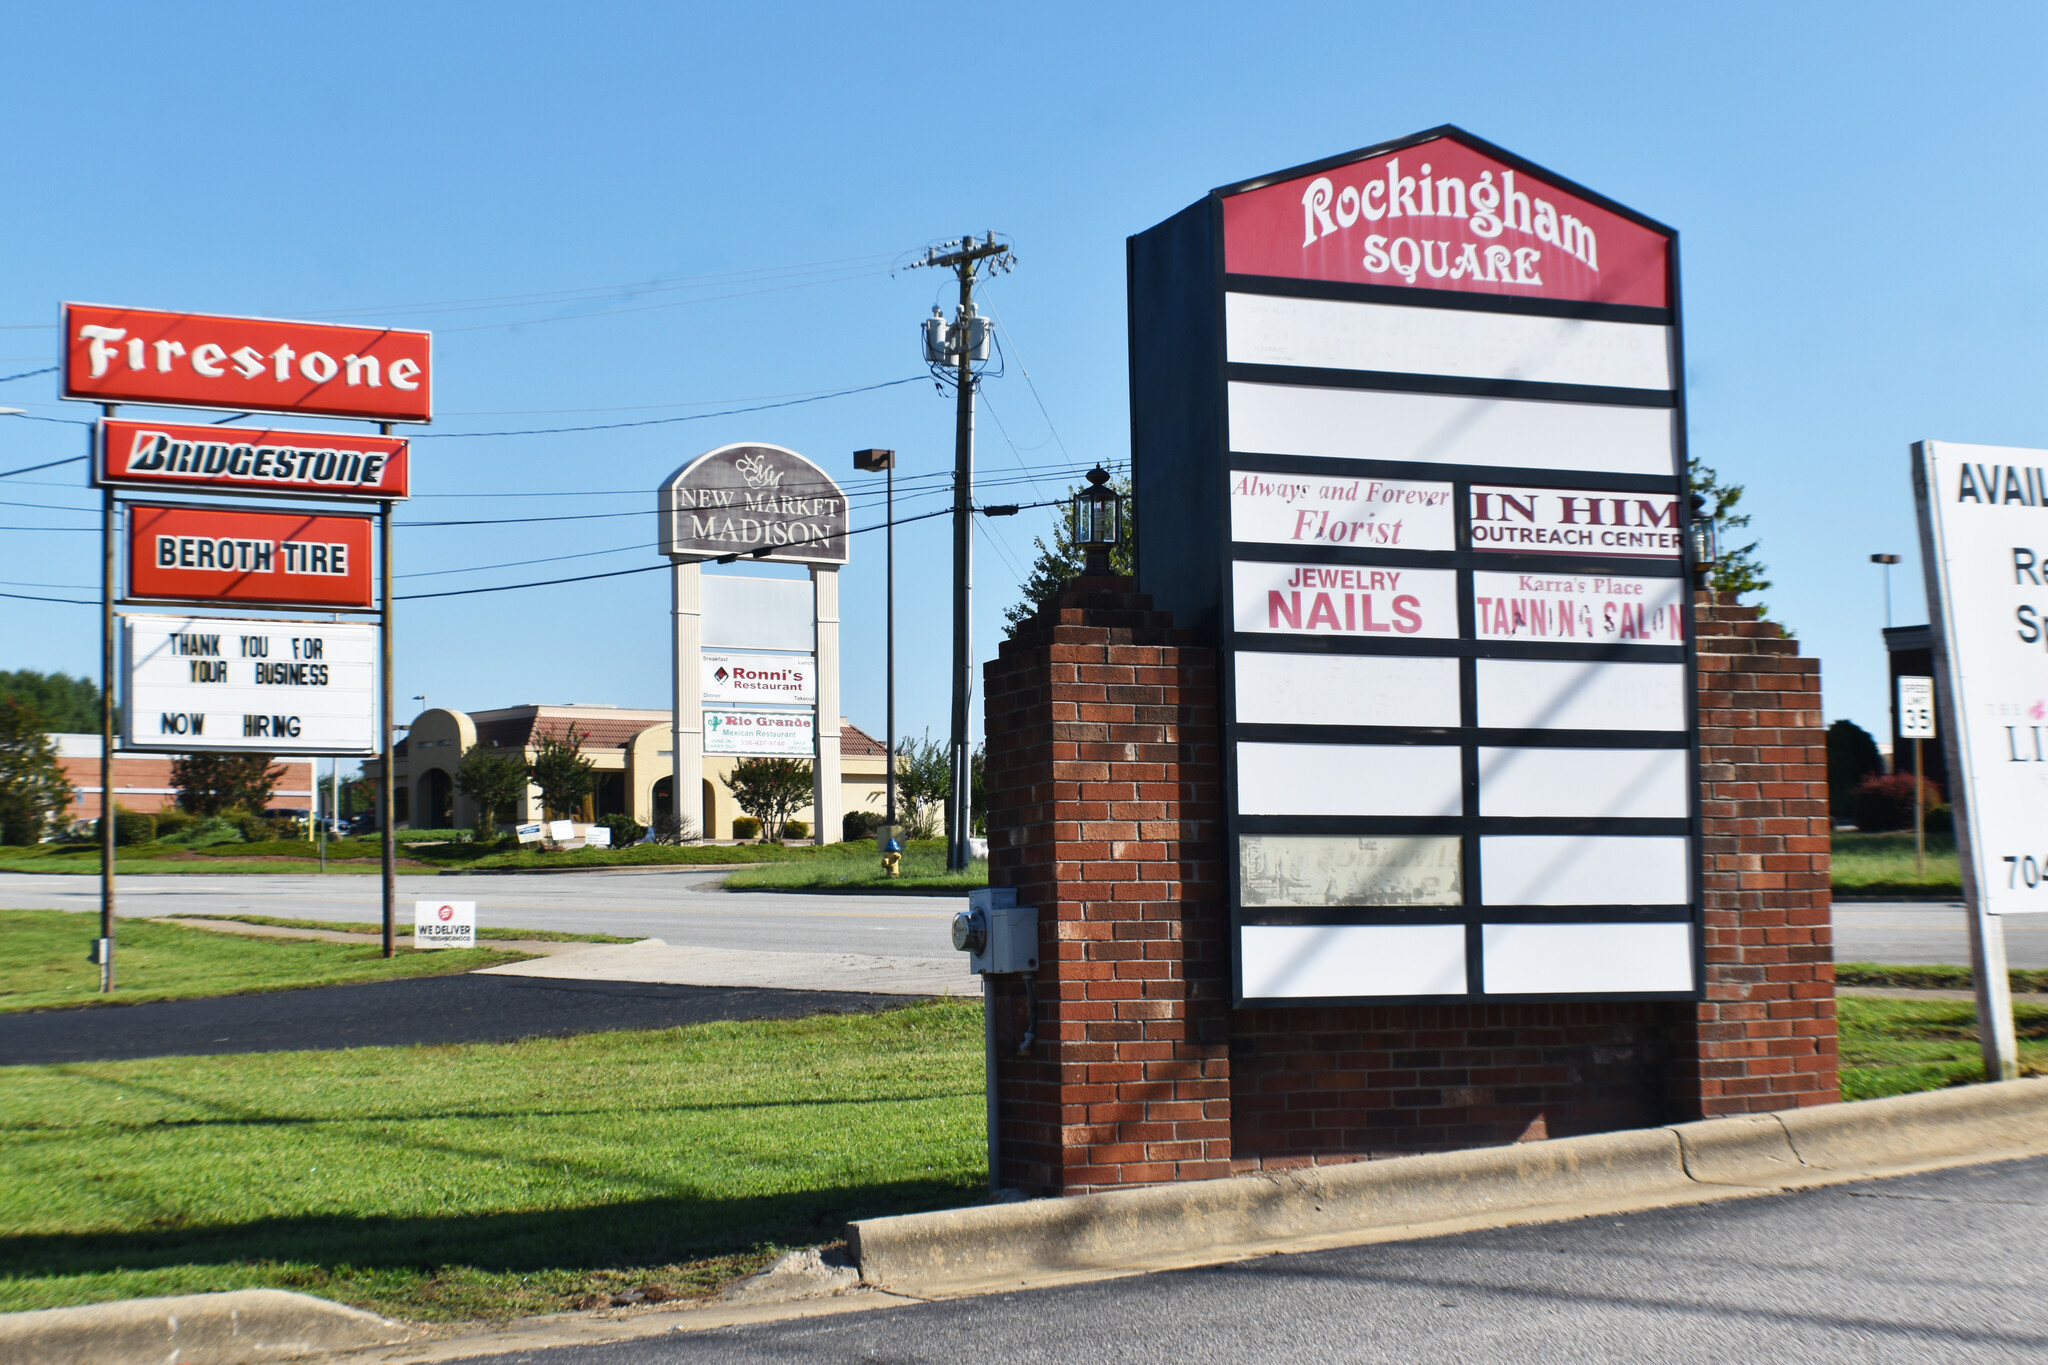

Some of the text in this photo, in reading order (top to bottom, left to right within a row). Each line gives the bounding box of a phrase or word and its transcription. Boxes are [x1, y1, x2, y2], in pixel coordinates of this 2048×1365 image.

[1302, 157, 1599, 272] Rockingham
[1363, 234, 1543, 286] SQUARE
[79, 324, 421, 391] Firestone
[126, 430, 389, 486] BRIDGESTONE
[679, 487, 839, 518] NEW MARKET
[1231, 475, 1450, 506] Always and Forever
[1470, 492, 1682, 529] IN HIM
[690, 514, 831, 549] MADISON
[1290, 509, 1403, 545] Florist
[1472, 525, 1684, 549] OUTREACH CENTER
[156, 535, 349, 577] BEROTH TIRE
[1288, 567, 1401, 592] JEWELRY
[1518, 575, 1643, 595] Karra's Place
[1269, 590, 1423, 635] NAILS
[169, 633, 323, 660] THANK YOU FOR
[190, 660, 328, 686] YOUR BUSINESS
[733, 667, 803, 682] Ronni's
[734, 680, 803, 691] Restaurant
[161, 712, 205, 736] NOW
[725, 715, 811, 727] Rio Grande
[1905, 709, 1931, 729] 35
[723, 729, 796, 738] Mexican Restaurant
[418, 925, 471, 935] WE DELIVER
